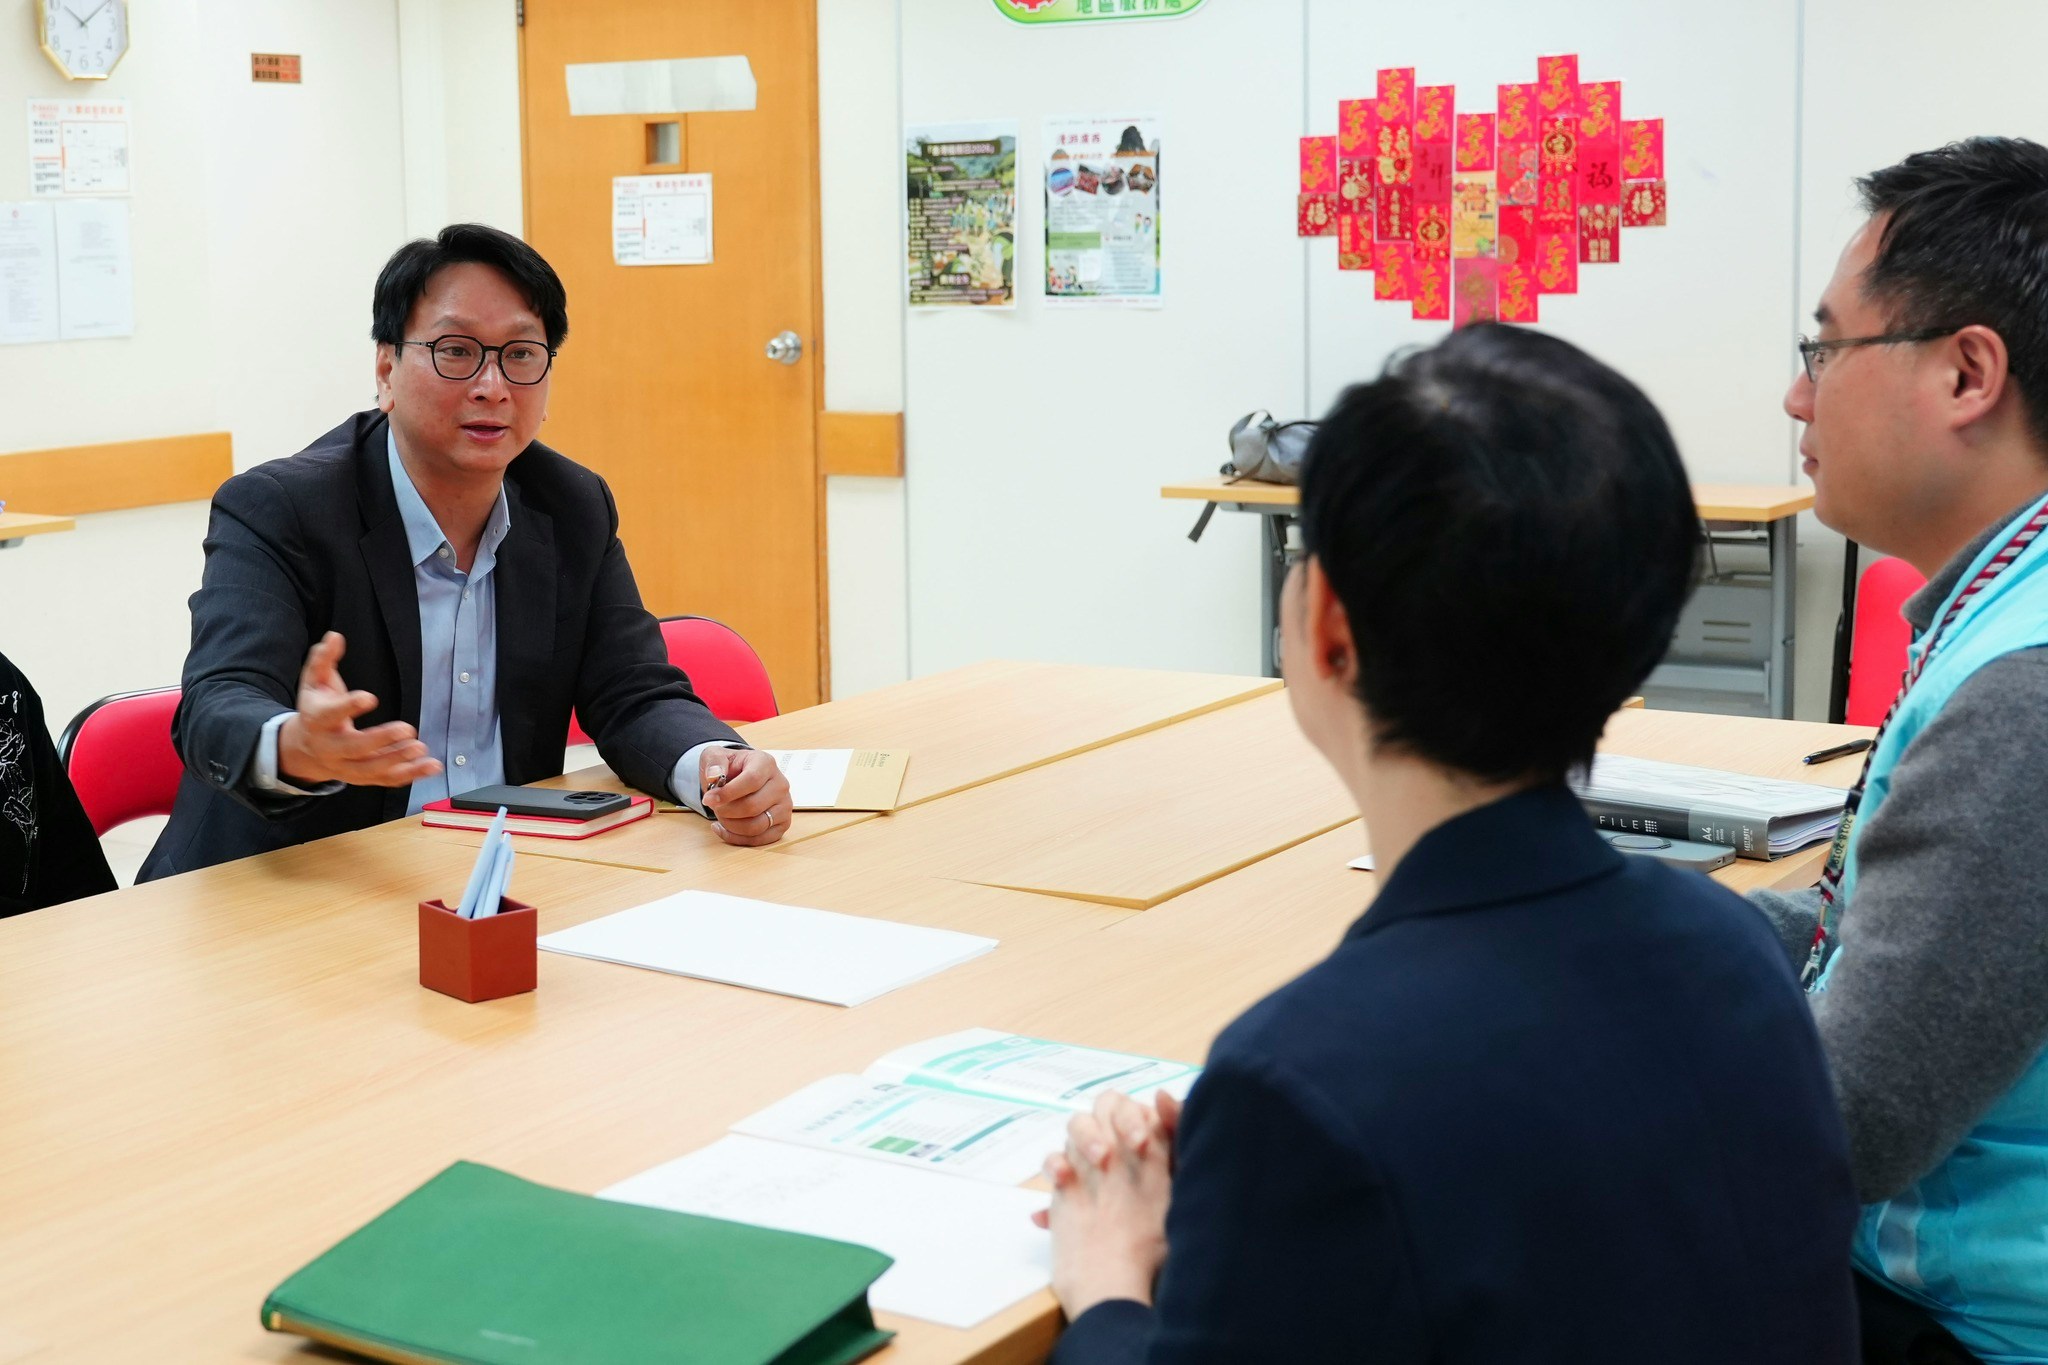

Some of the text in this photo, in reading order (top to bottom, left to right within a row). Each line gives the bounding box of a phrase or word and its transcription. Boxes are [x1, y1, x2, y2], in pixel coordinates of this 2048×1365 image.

[48, 15, 56, 31] 9
[109, 16, 117, 33] 3
[53, 35, 61, 51] 8
[105, 37, 113, 50] 4
[64, 49, 72, 65] 7
[79, 54, 89, 70] 6
[96, 51, 104, 67] 5
[1586, 162, 1613, 189] 福
[1599, 815, 1639, 830] FILE
[1701, 826, 1713, 842] A4
[1833, 818, 1853, 865] 2018-2019
